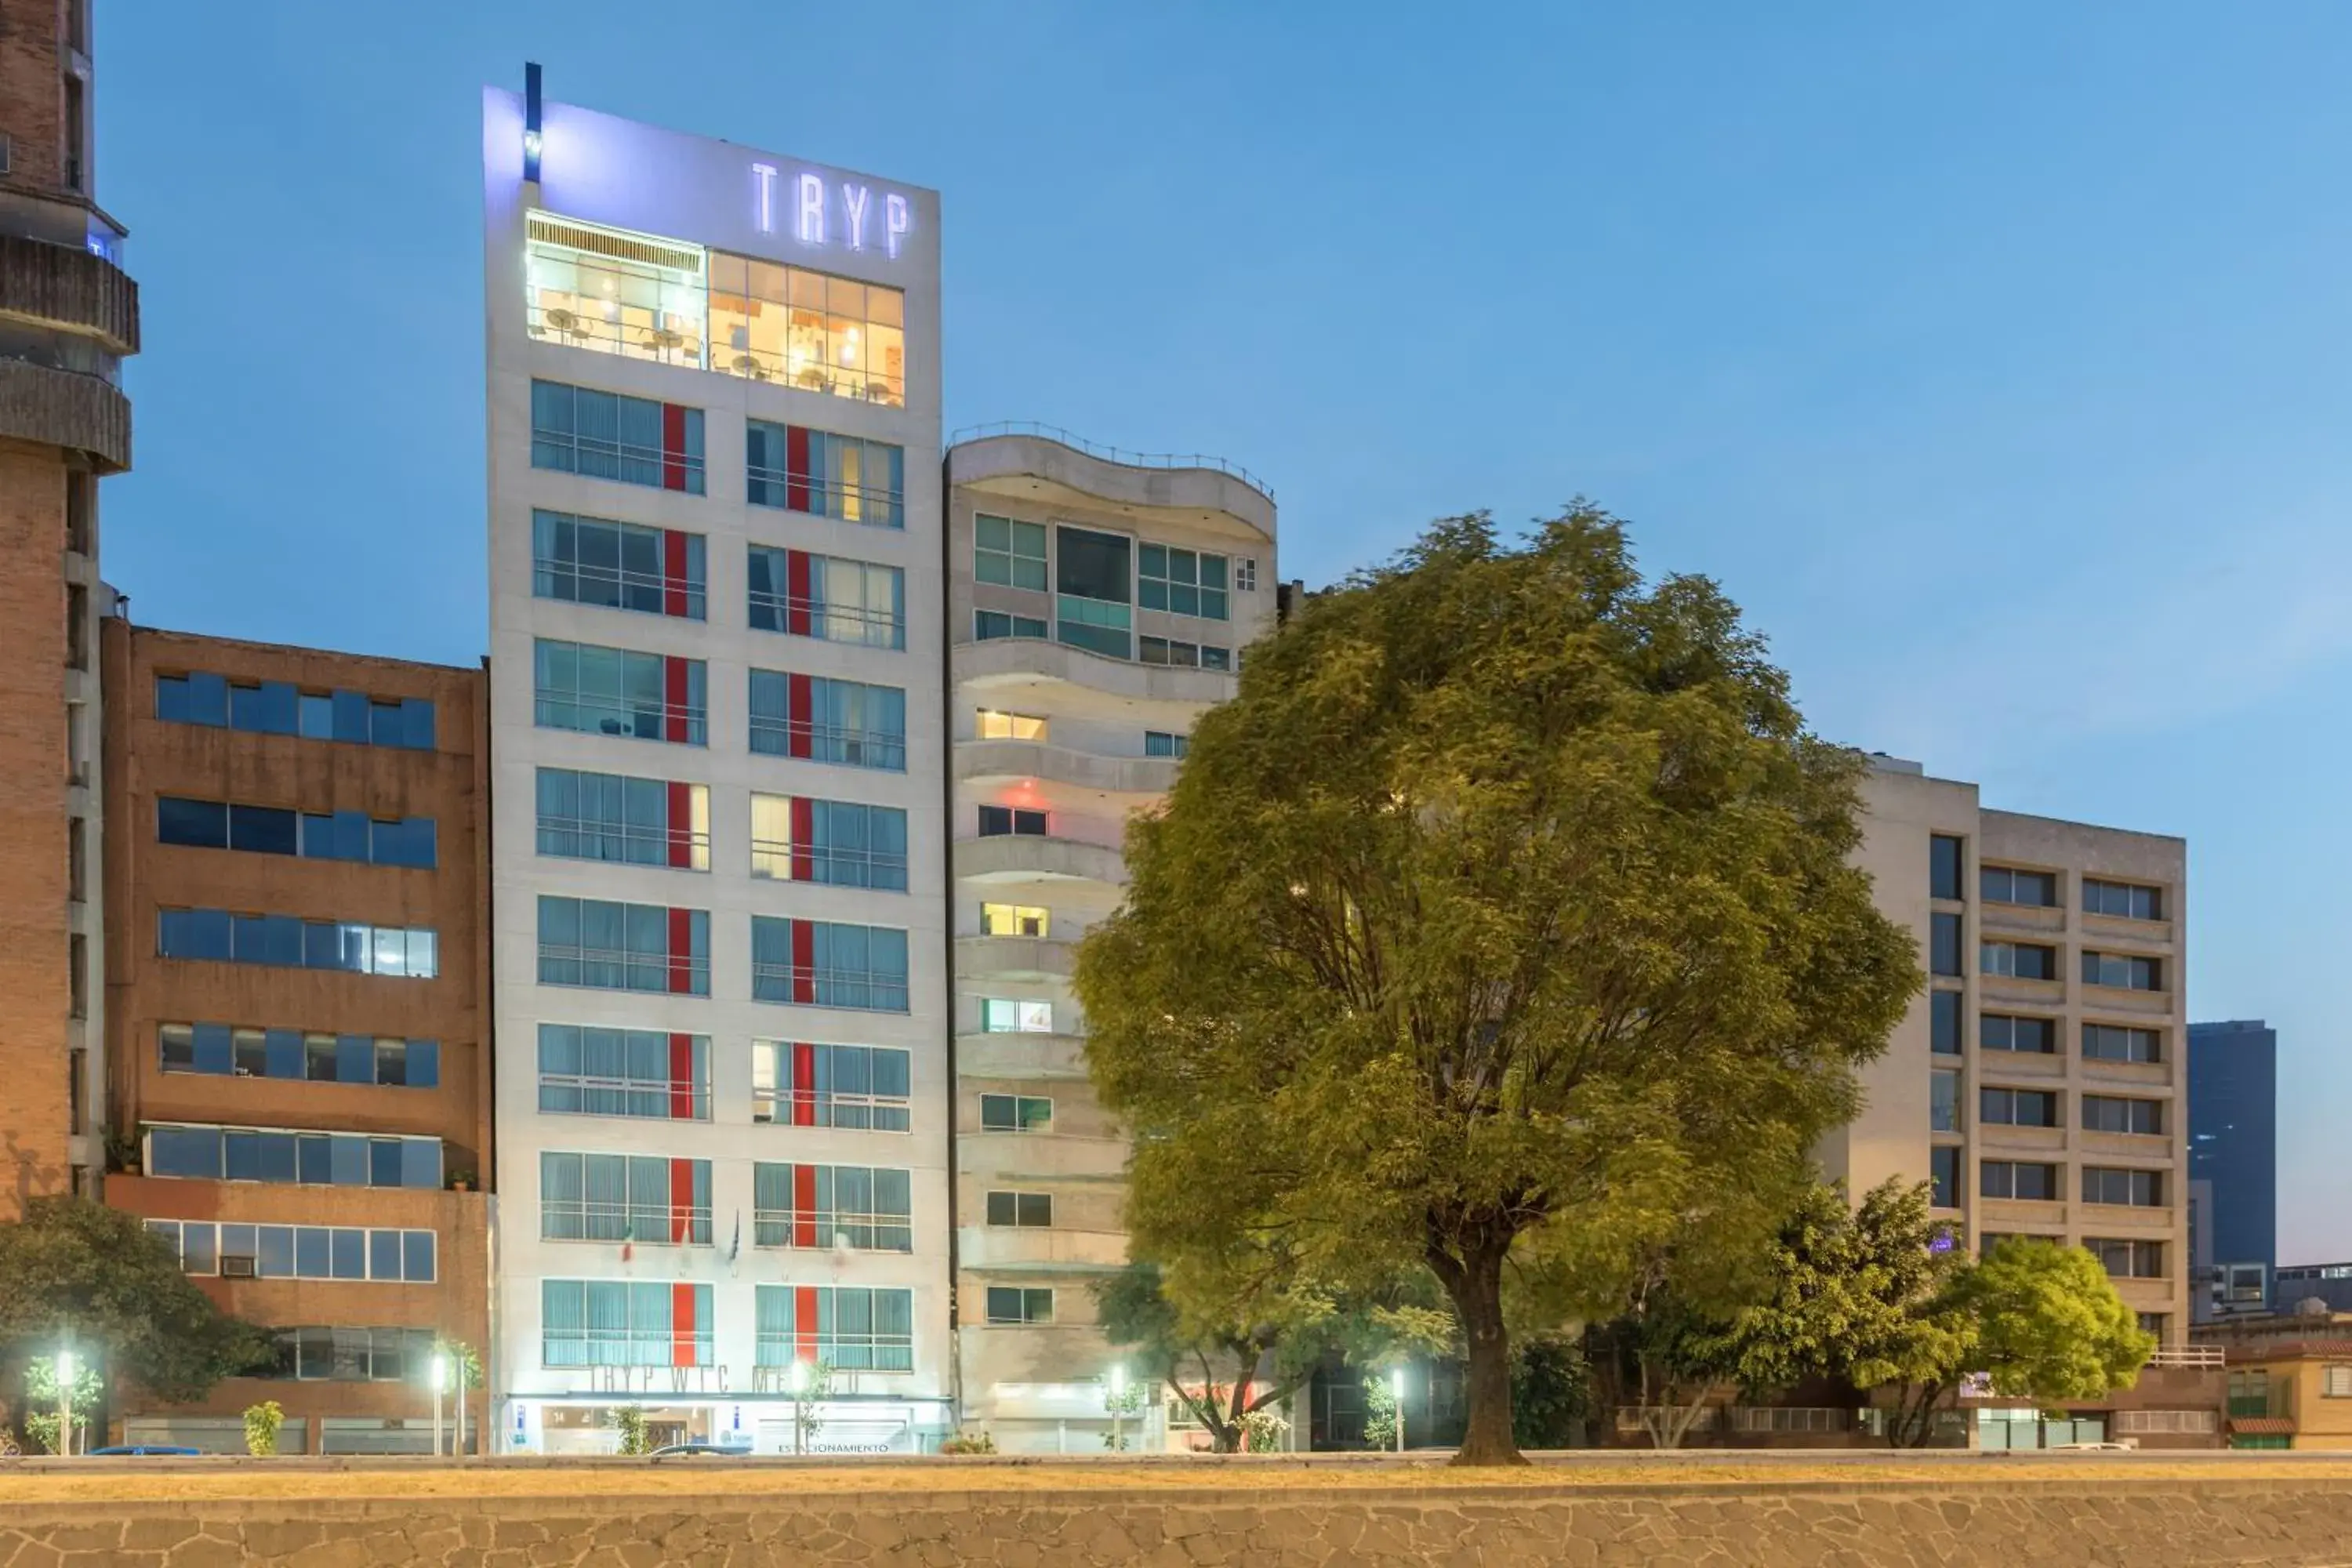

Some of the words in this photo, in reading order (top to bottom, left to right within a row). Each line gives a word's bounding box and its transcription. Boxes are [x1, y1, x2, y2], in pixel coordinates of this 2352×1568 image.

[752, 162, 908, 260] TRYP
[587, 1364, 653, 1393] TRYP
[670, 1364, 728, 1393] WTC
[752, 1365, 859, 1394] MECO
[779, 1443, 889, 1453] ESACIONAMIENTO
